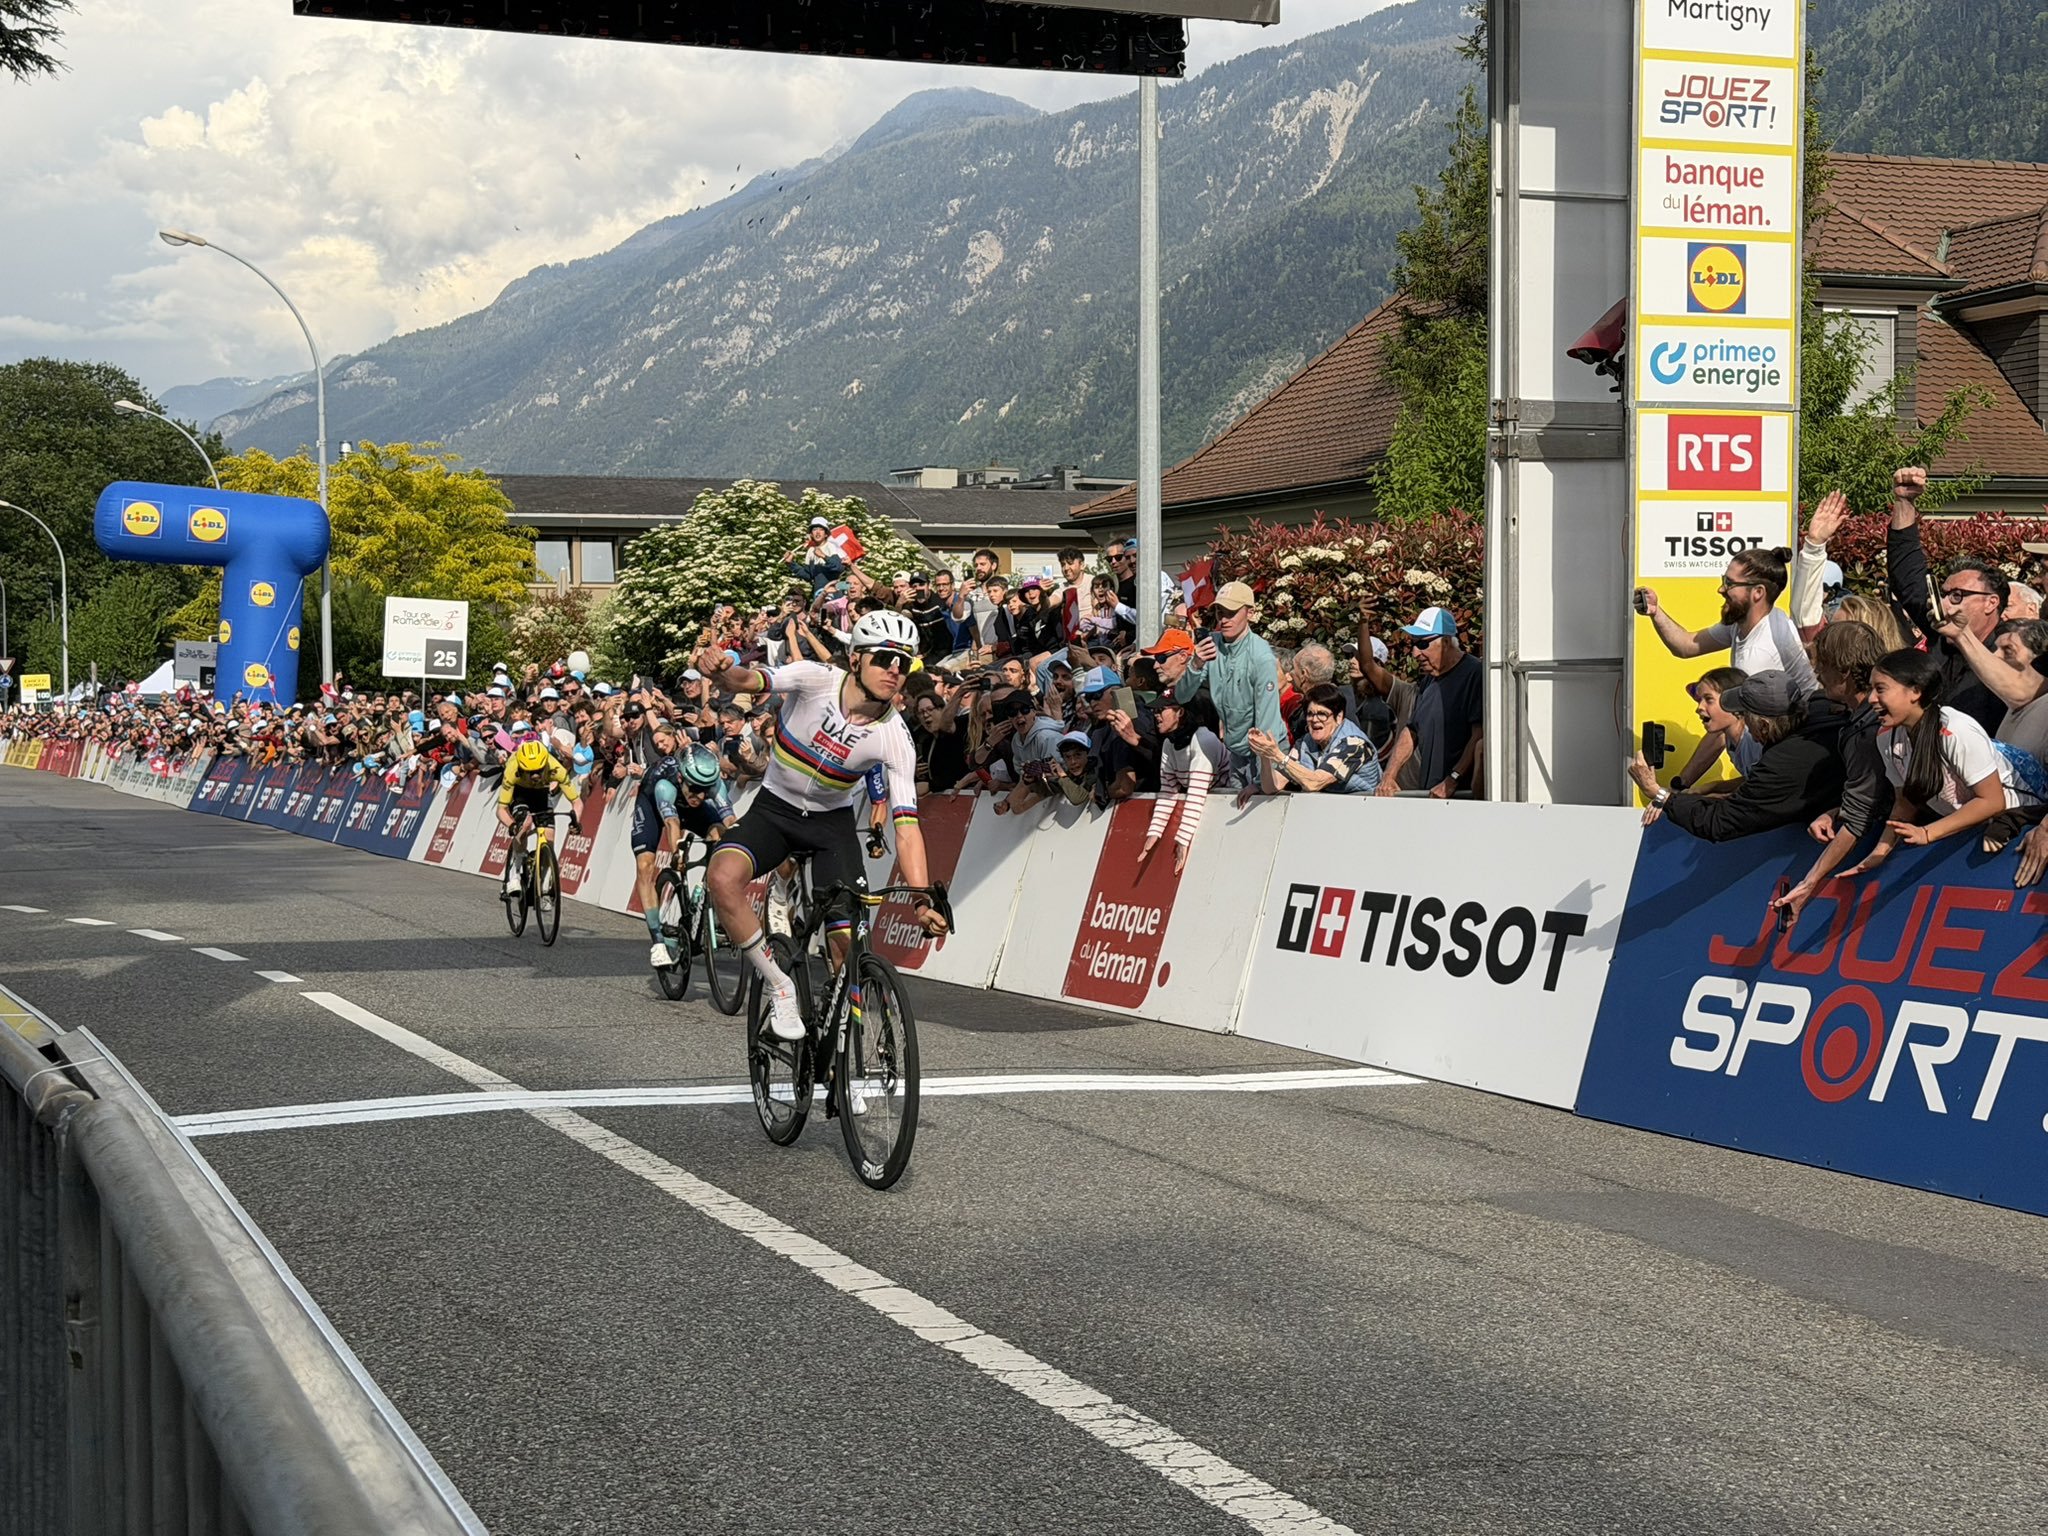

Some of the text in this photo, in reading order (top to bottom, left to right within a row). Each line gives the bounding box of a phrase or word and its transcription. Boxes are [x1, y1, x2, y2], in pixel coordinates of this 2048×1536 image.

[1667, 0, 1771, 31] Martigny
[1664, 74, 1771, 103] JOUEZ
[1665, 155, 1764, 194] banque
[1663, 194, 1681, 210] du
[1693, 338, 1776, 364] primeo
[1692, 364, 1781, 393] energie
[1677, 433, 1753, 472] RTS
[1664, 536, 1763, 557] TISSOT
[402, 610, 418, 619] Tour
[433, 650, 457, 668] 25
[37, 691, 50, 700] 100
[821, 716, 861, 748] UAE
[1089, 891, 1161, 943] banque
[1080, 939, 1095, 959] du
[1360, 891, 1588, 992] TISSOT
[1669, 975, 2048, 1132] SPORT
